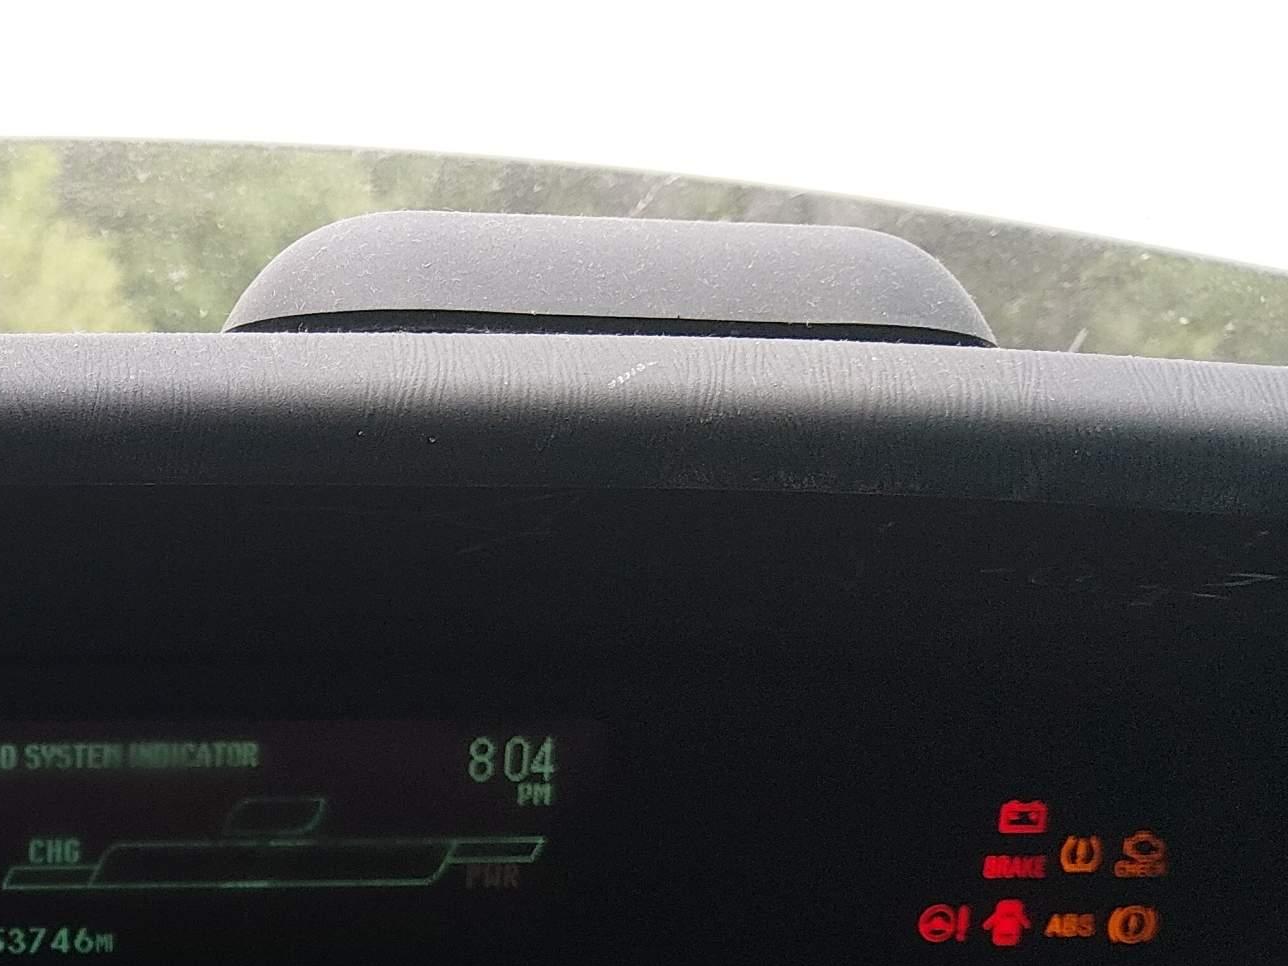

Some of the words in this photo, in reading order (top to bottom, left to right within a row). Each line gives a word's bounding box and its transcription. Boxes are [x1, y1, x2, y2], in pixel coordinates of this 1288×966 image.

[24, 742, 122, 769] SYSTEM
[518, 783, 552, 806] PM
[28, 838, 81, 864] CHG
[1043, 912, 1097, 938] ABS
